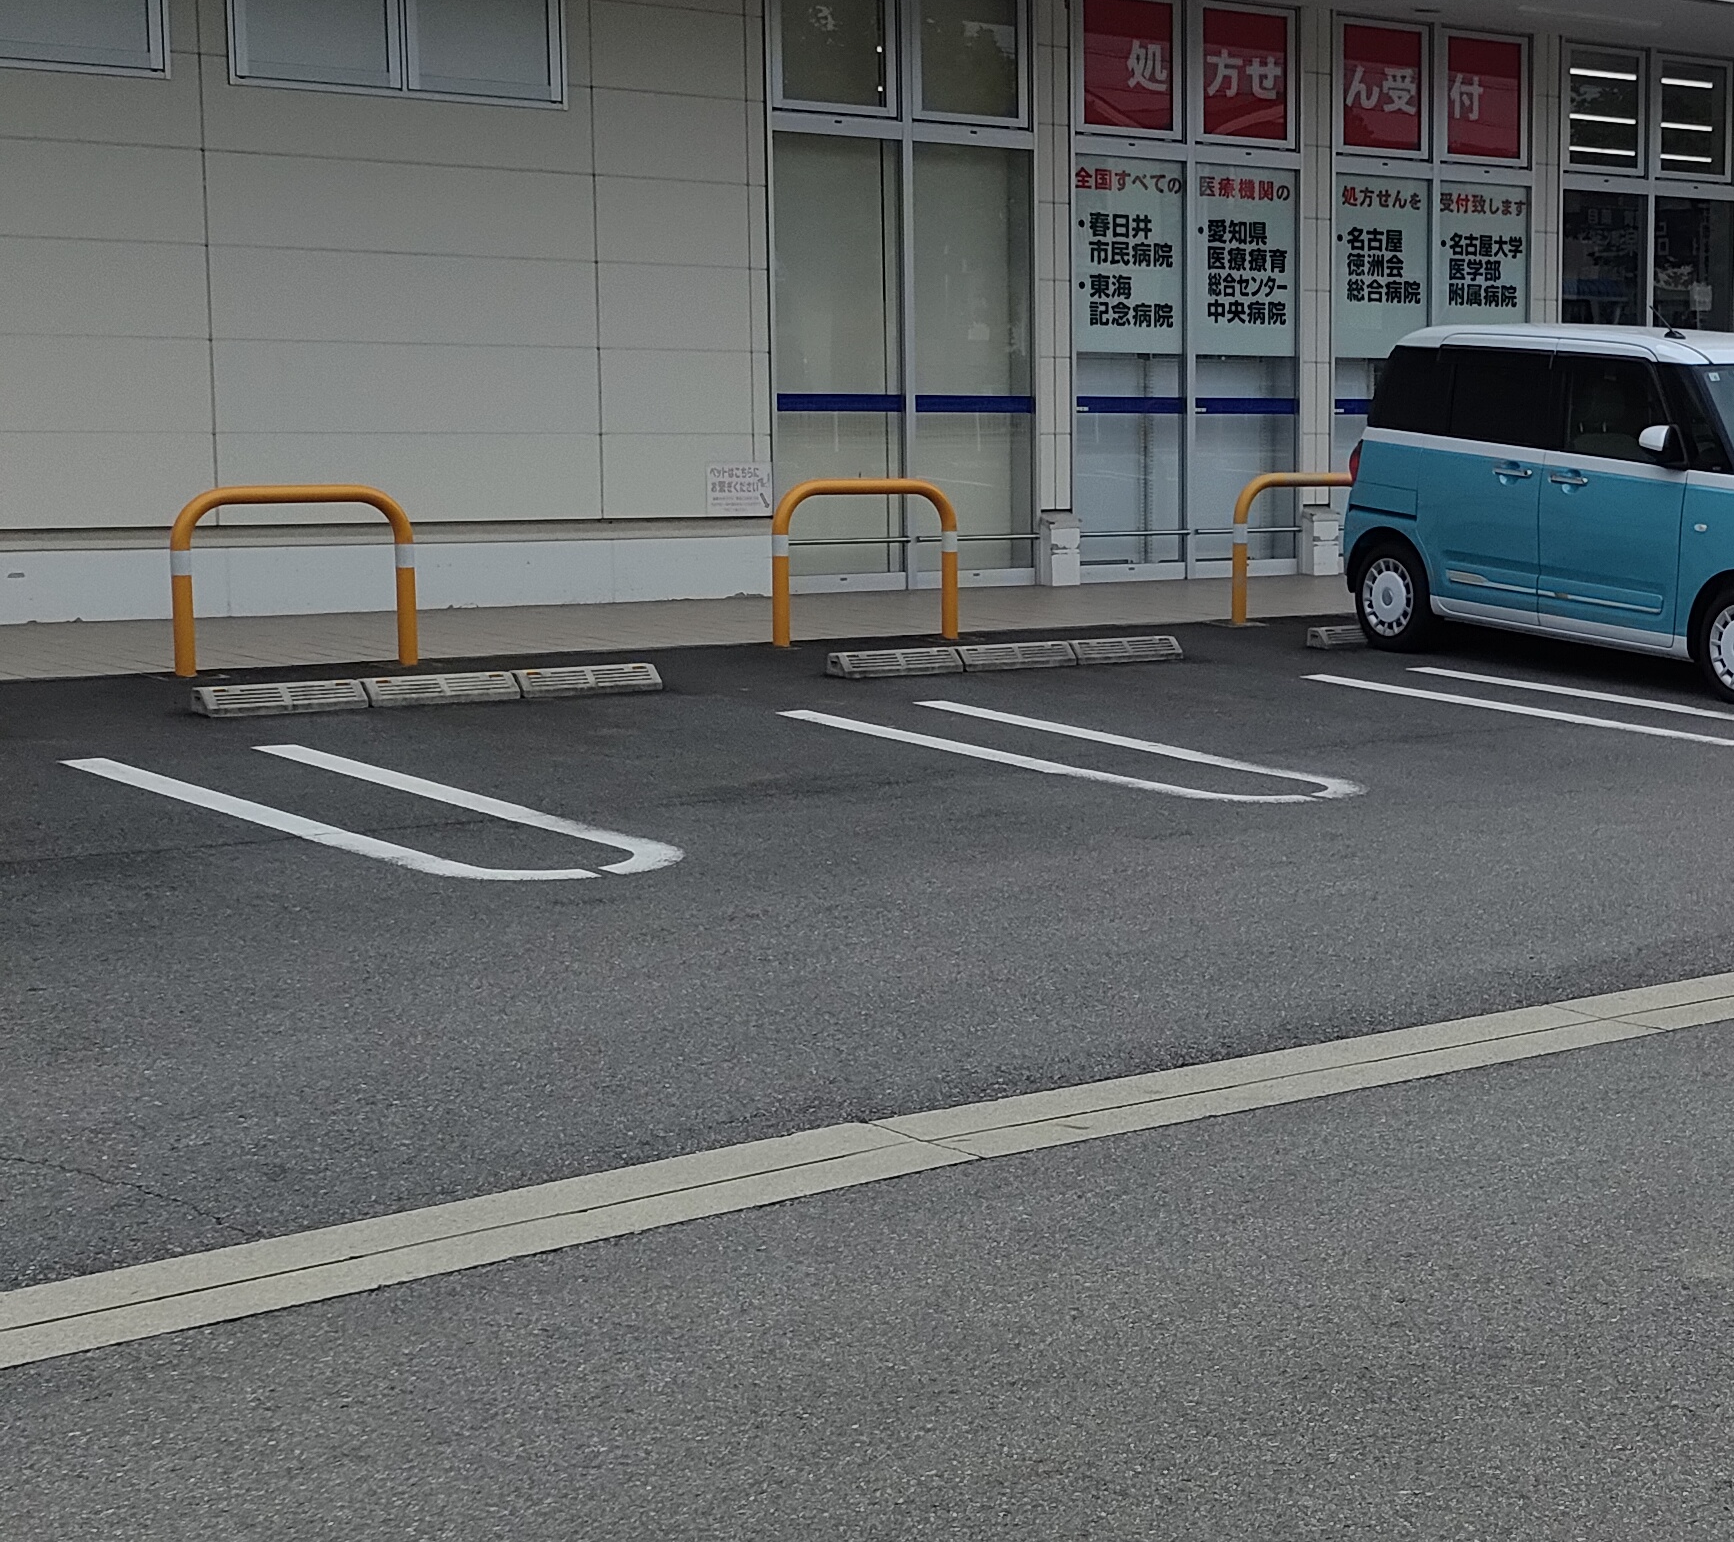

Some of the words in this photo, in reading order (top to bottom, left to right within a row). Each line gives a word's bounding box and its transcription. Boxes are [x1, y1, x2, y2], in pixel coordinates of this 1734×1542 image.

[1074, 166, 1183, 195] 全国すべての
[1199, 176, 1291, 202] 医療機関の
[1341, 185, 1422, 210] 処方せんを
[1440, 192, 1527, 217] 受付致します
[1088, 240, 1174, 268] 市民病院
[1207, 246, 1288, 274] 医療療育
[1346, 252, 1404, 279] 徳洲会
[1448, 258, 1502, 283] 医学部
[1207, 272, 1288, 298] 総合センター
[1346, 279, 1422, 305] 総合病院
[1448, 283, 1518, 308] 附属病院
[1088, 301, 1174, 329] 記念病院
[1207, 299, 1287, 326] 中央病院
